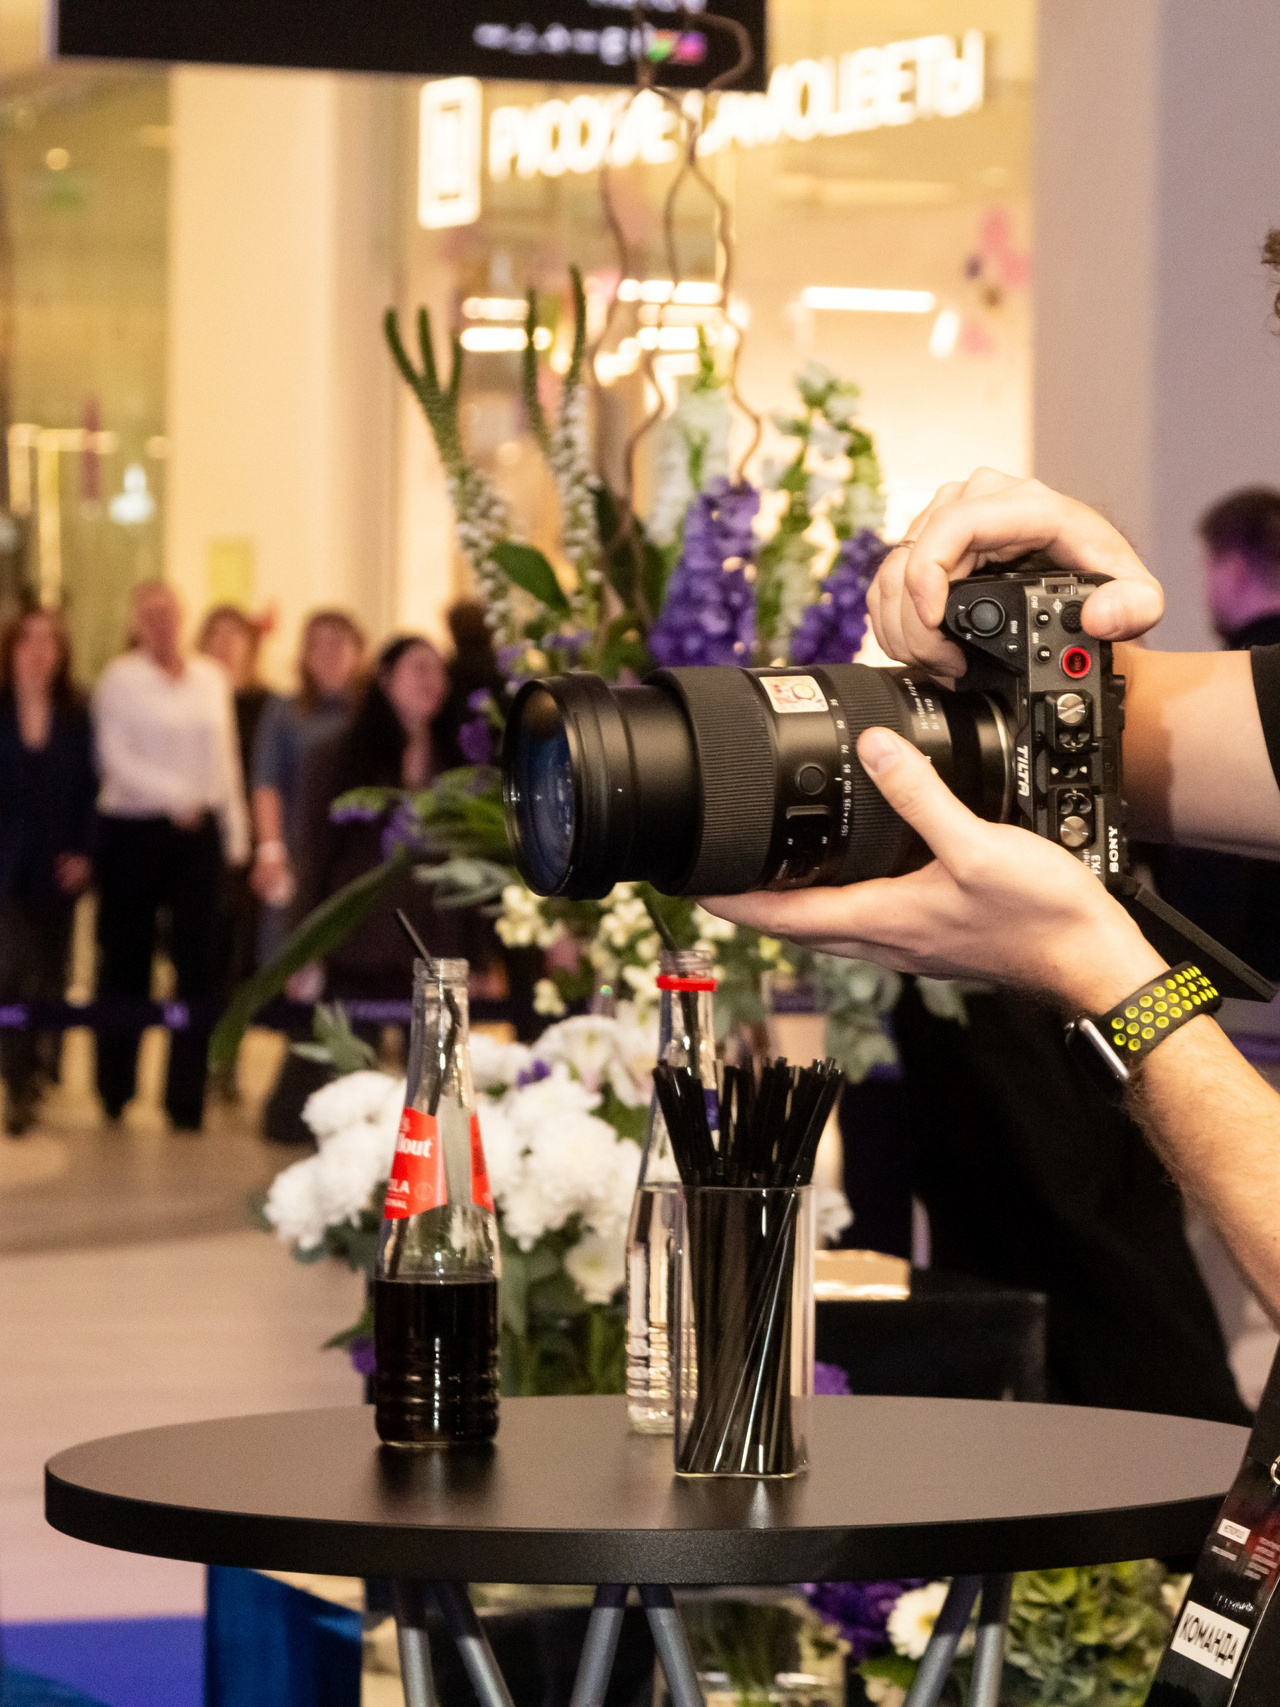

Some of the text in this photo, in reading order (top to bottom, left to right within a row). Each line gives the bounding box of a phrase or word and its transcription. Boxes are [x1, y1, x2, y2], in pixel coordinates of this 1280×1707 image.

[836, 719, 846, 729] 50
[840, 744, 850, 754] 70
[843, 763, 852, 774] 85
[1016, 744, 1030, 797] TILTA
[844, 780, 852, 793] 100
[844, 798, 852, 810] 135
[841, 824, 849, 836] 150
[1108, 825, 1119, 873] SONY
[1090, 854, 1102, 875] FX3
[1178, 1612, 1240, 1666] КОМАНДА
